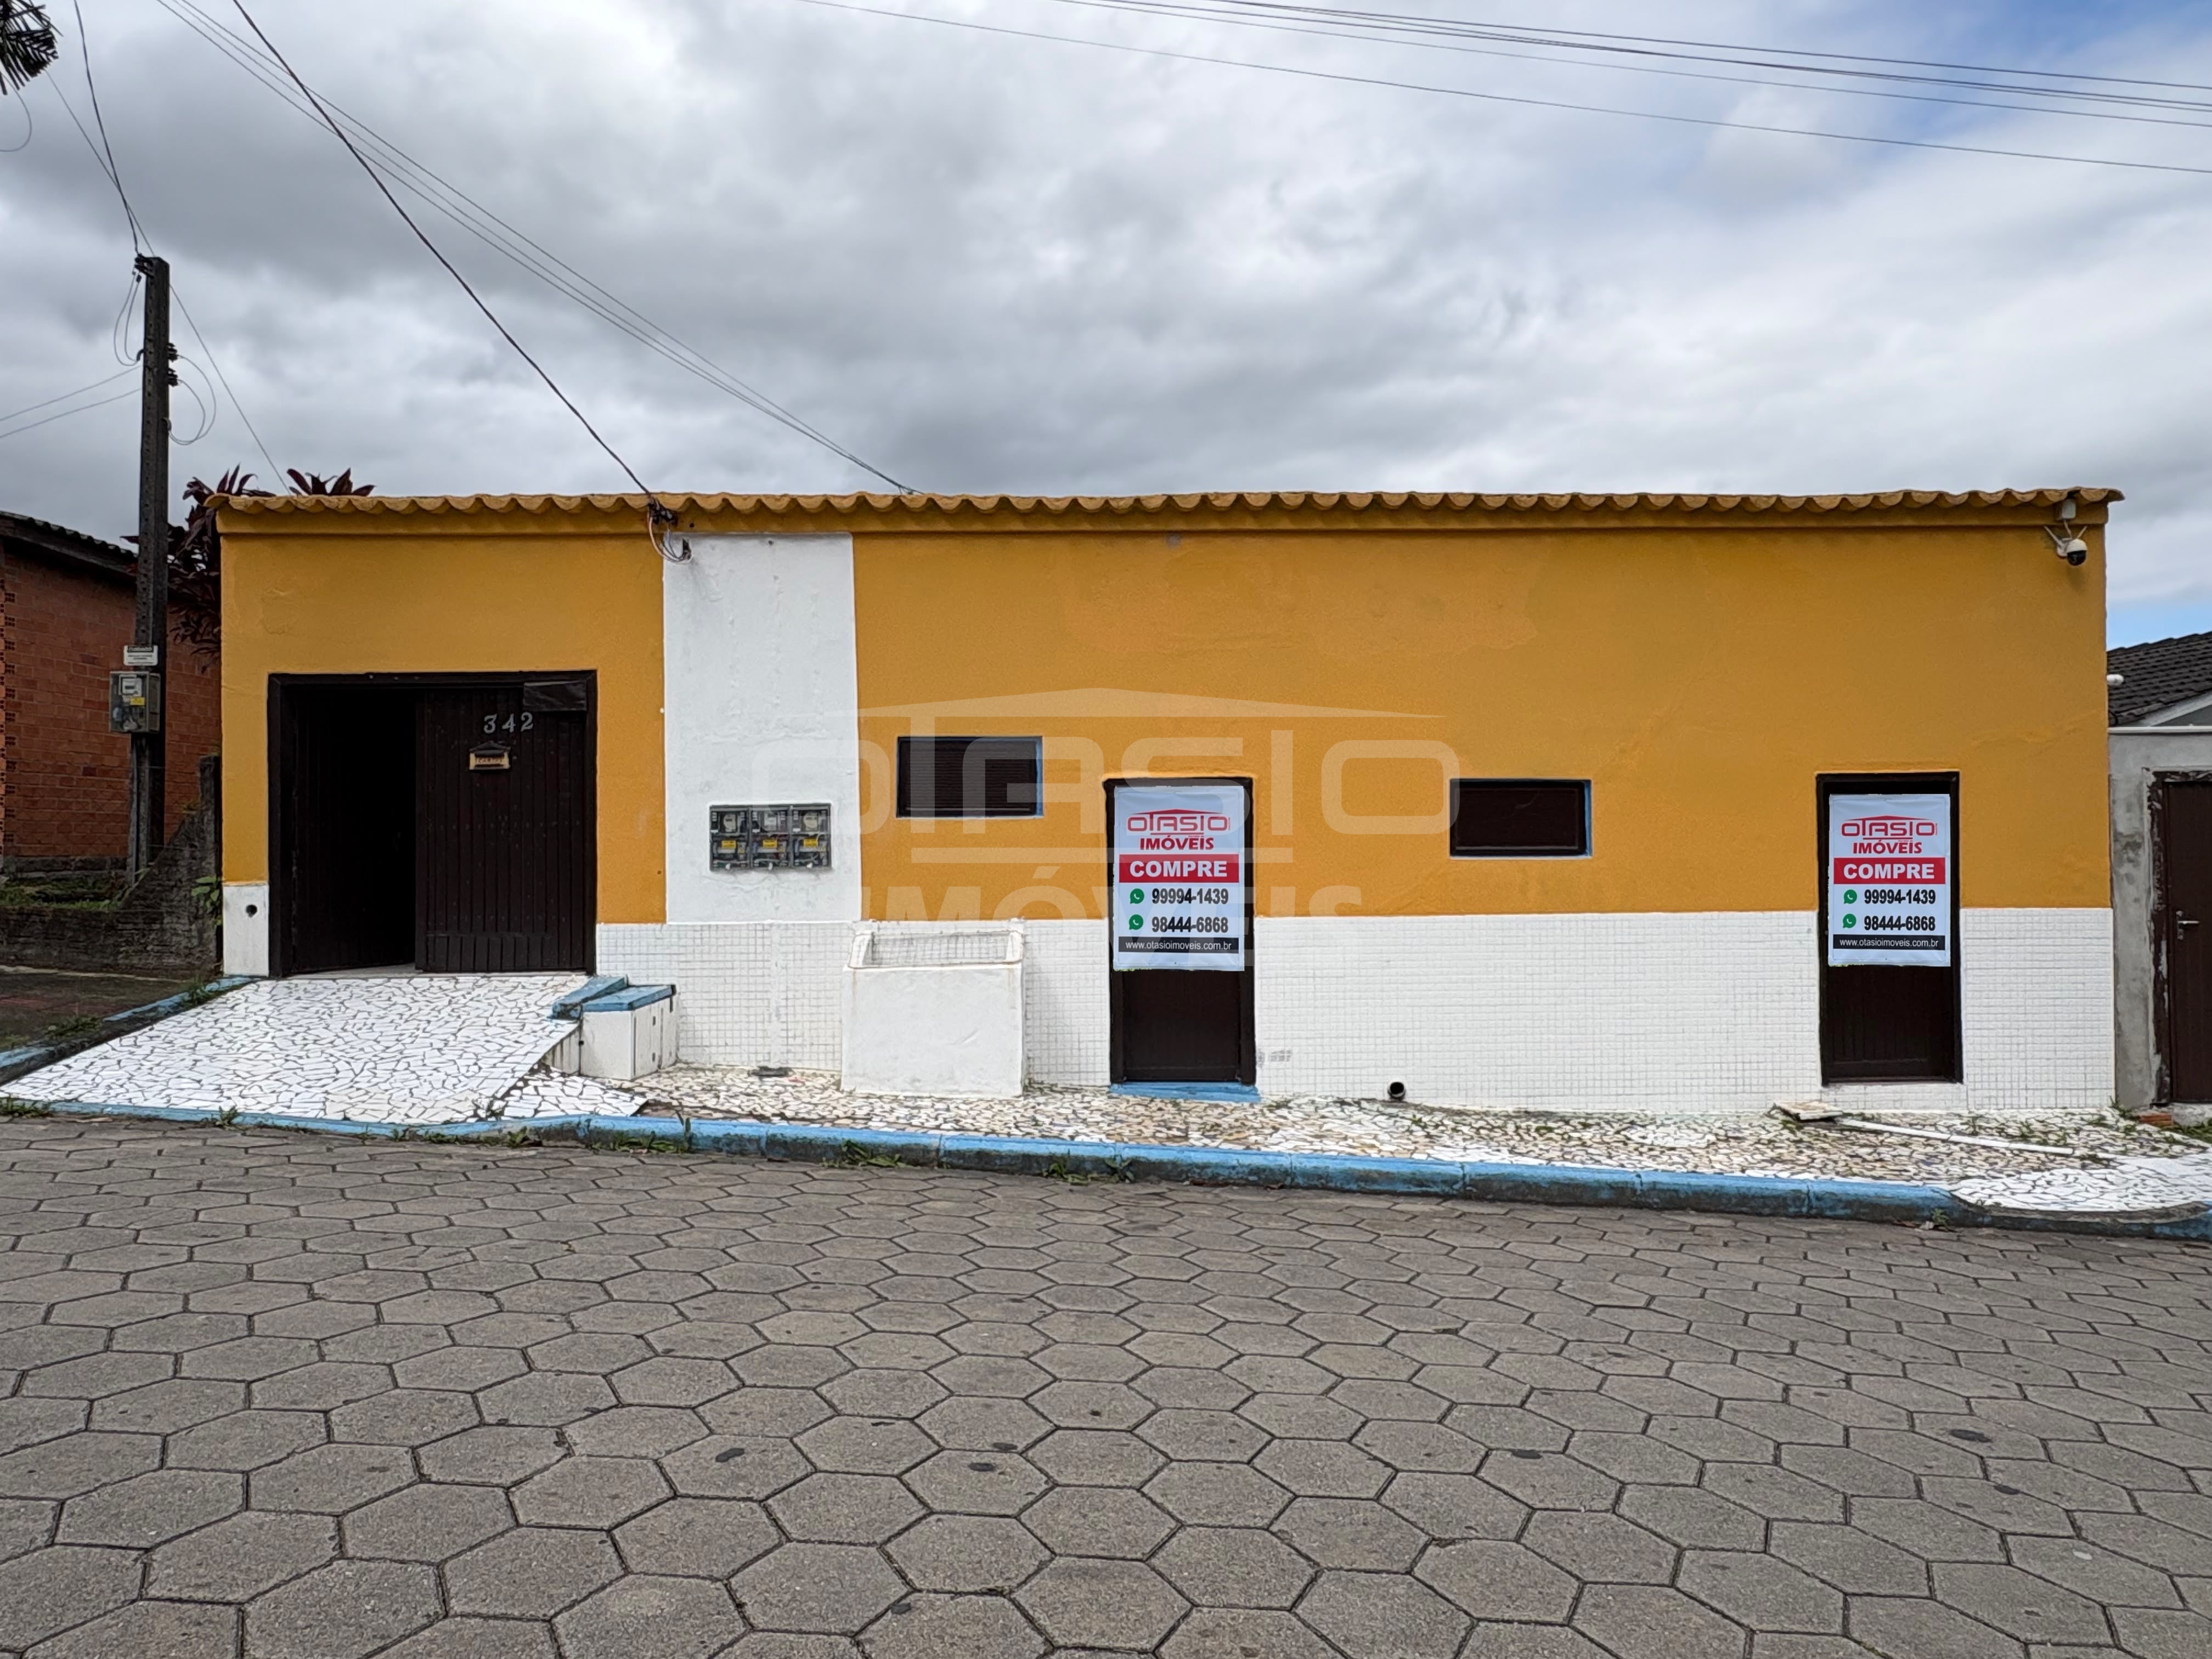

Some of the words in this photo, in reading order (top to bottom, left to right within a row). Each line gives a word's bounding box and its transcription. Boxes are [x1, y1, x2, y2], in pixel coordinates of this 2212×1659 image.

[483, 712, 533, 733] 342
[1127, 814, 1228, 832] OTASIO
[1841, 820, 1935, 837] OTASIO
[1140, 835, 1214, 850] IMÓVEIS
[1853, 840, 1922, 854] IMÓVEIS
[1130, 860, 1227, 877] COMPRE
[1843, 864, 1934, 879] COMPRE
[1152, 888, 1229, 904] 99994-1439
[1864, 889, 1936, 905] 99994-1439
[1152, 916, 1228, 933] 98444-6868
[1864, 916, 1936, 931] 98444-6868
[1125, 940, 1232, 950] www.otasioimoveis.com.br
[1839, 938, 1939, 947] www.otasioimoveis.com.br
